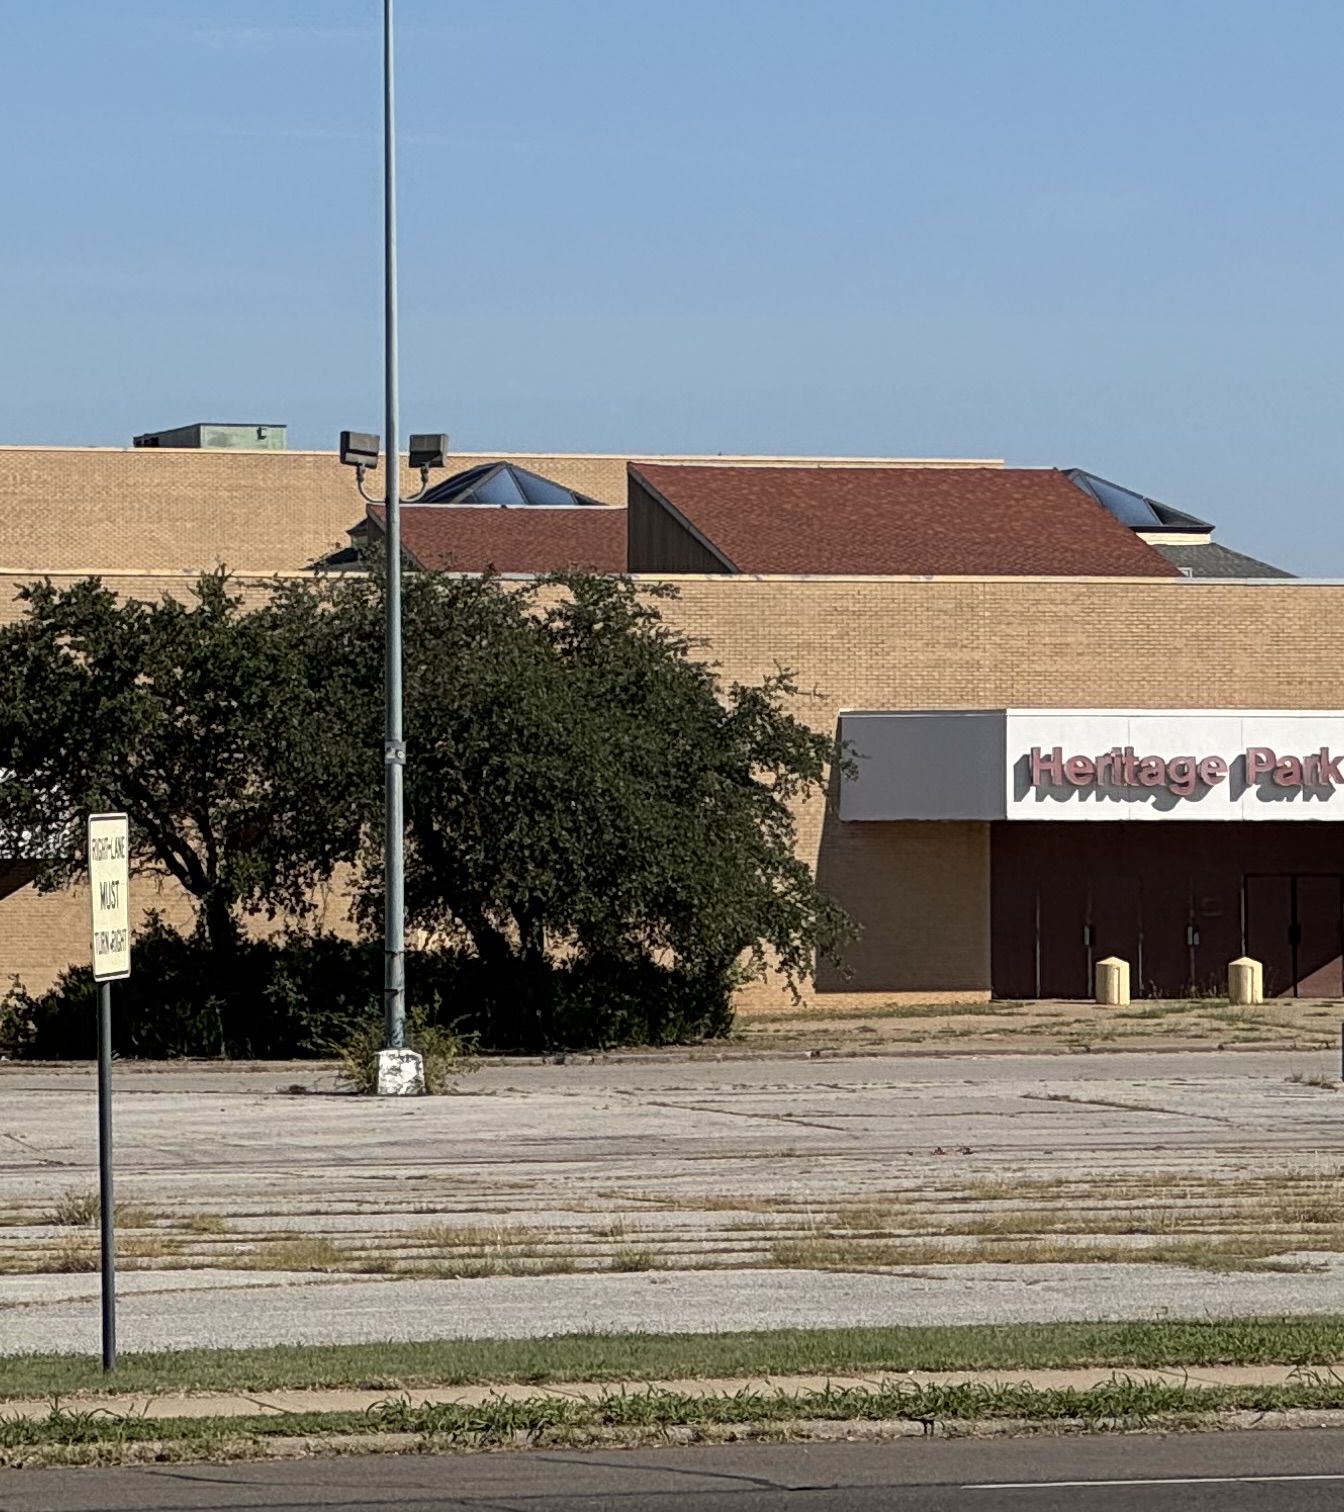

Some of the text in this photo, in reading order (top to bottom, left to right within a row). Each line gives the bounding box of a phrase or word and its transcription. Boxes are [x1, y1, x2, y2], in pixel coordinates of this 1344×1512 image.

[1029, 746, 1228, 796] Heritage
[111, 836, 125, 859] LANE
[100, 880, 119, 910] MUST
